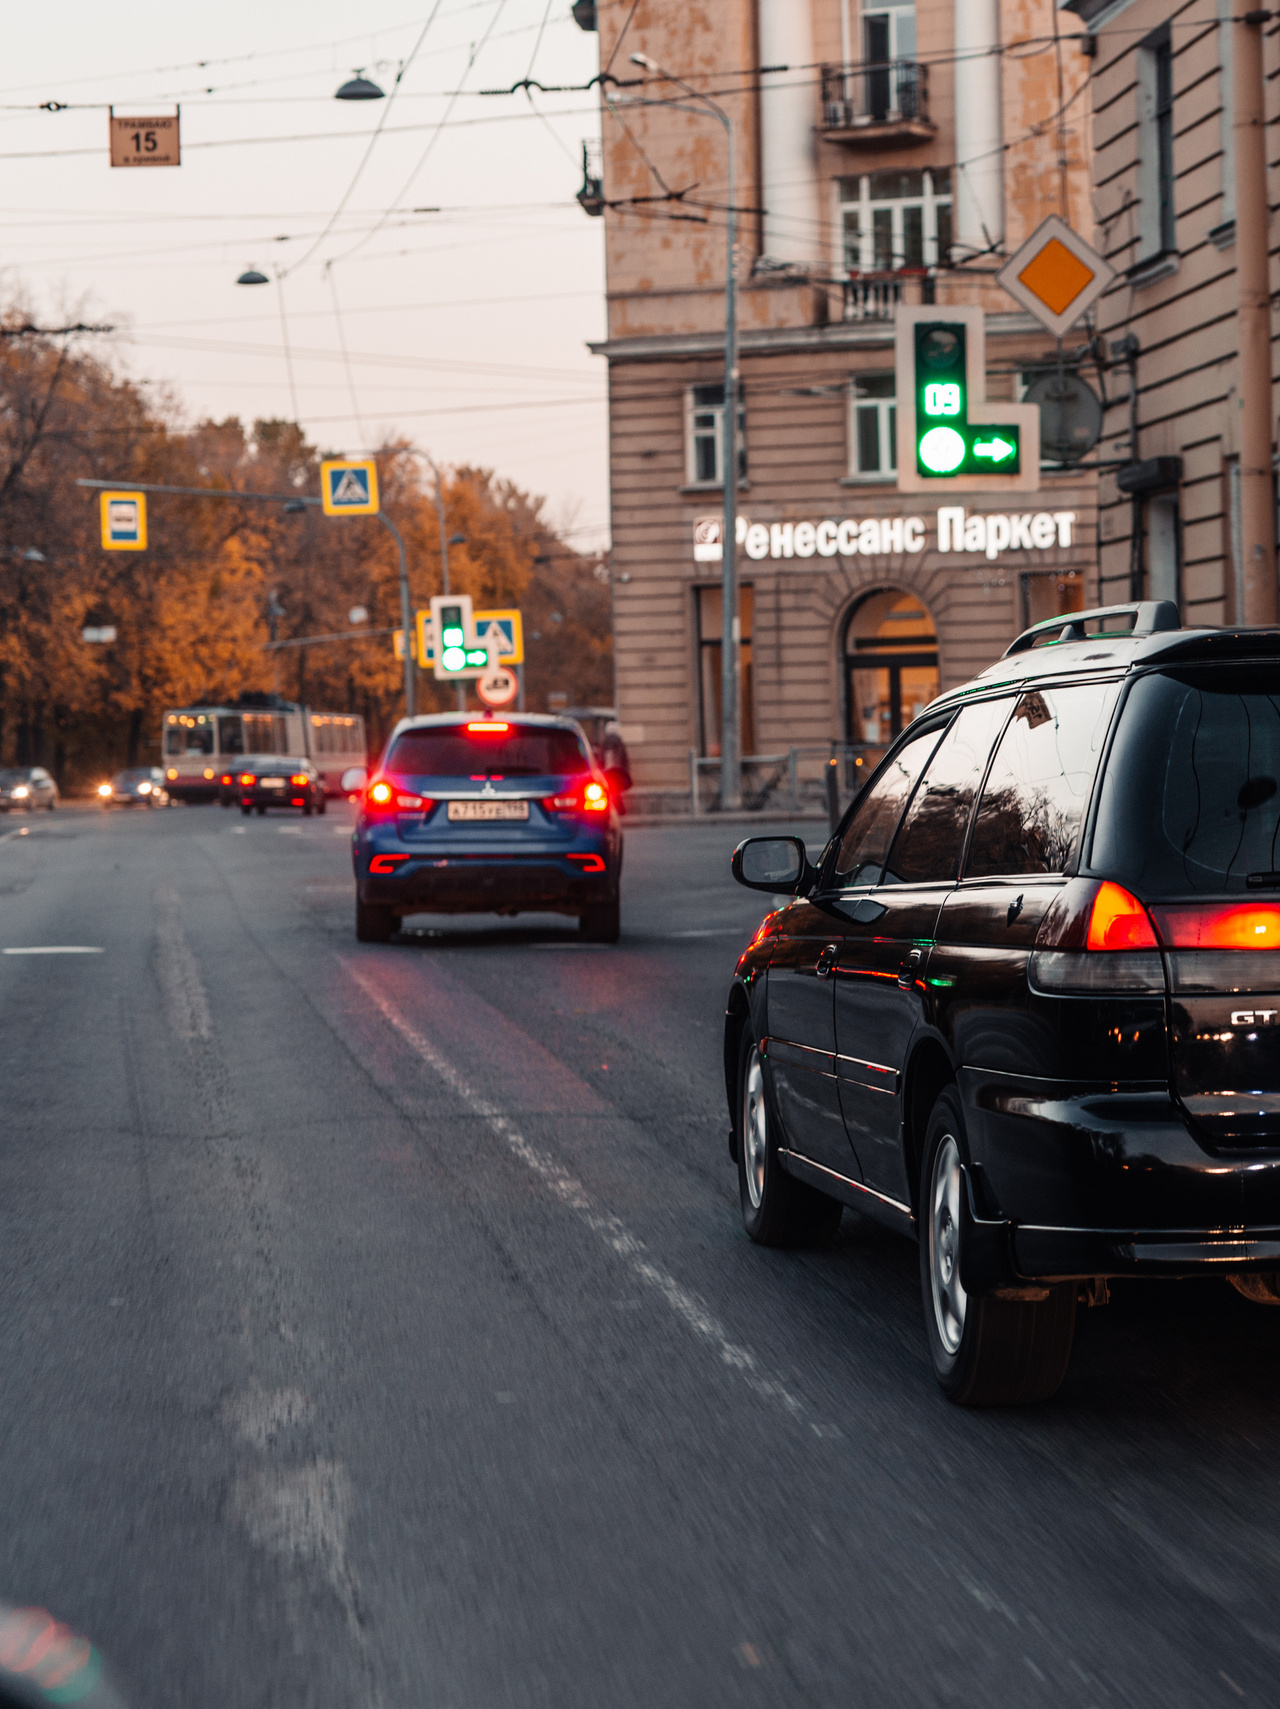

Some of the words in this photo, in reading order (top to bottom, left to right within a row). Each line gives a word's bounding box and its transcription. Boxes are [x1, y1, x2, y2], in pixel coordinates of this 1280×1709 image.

[130, 131, 158, 152] 15
[924, 382, 961, 416] 09
[936, 505, 1078, 560] Паркет
[1231, 1009, 1278, 1025] GT
